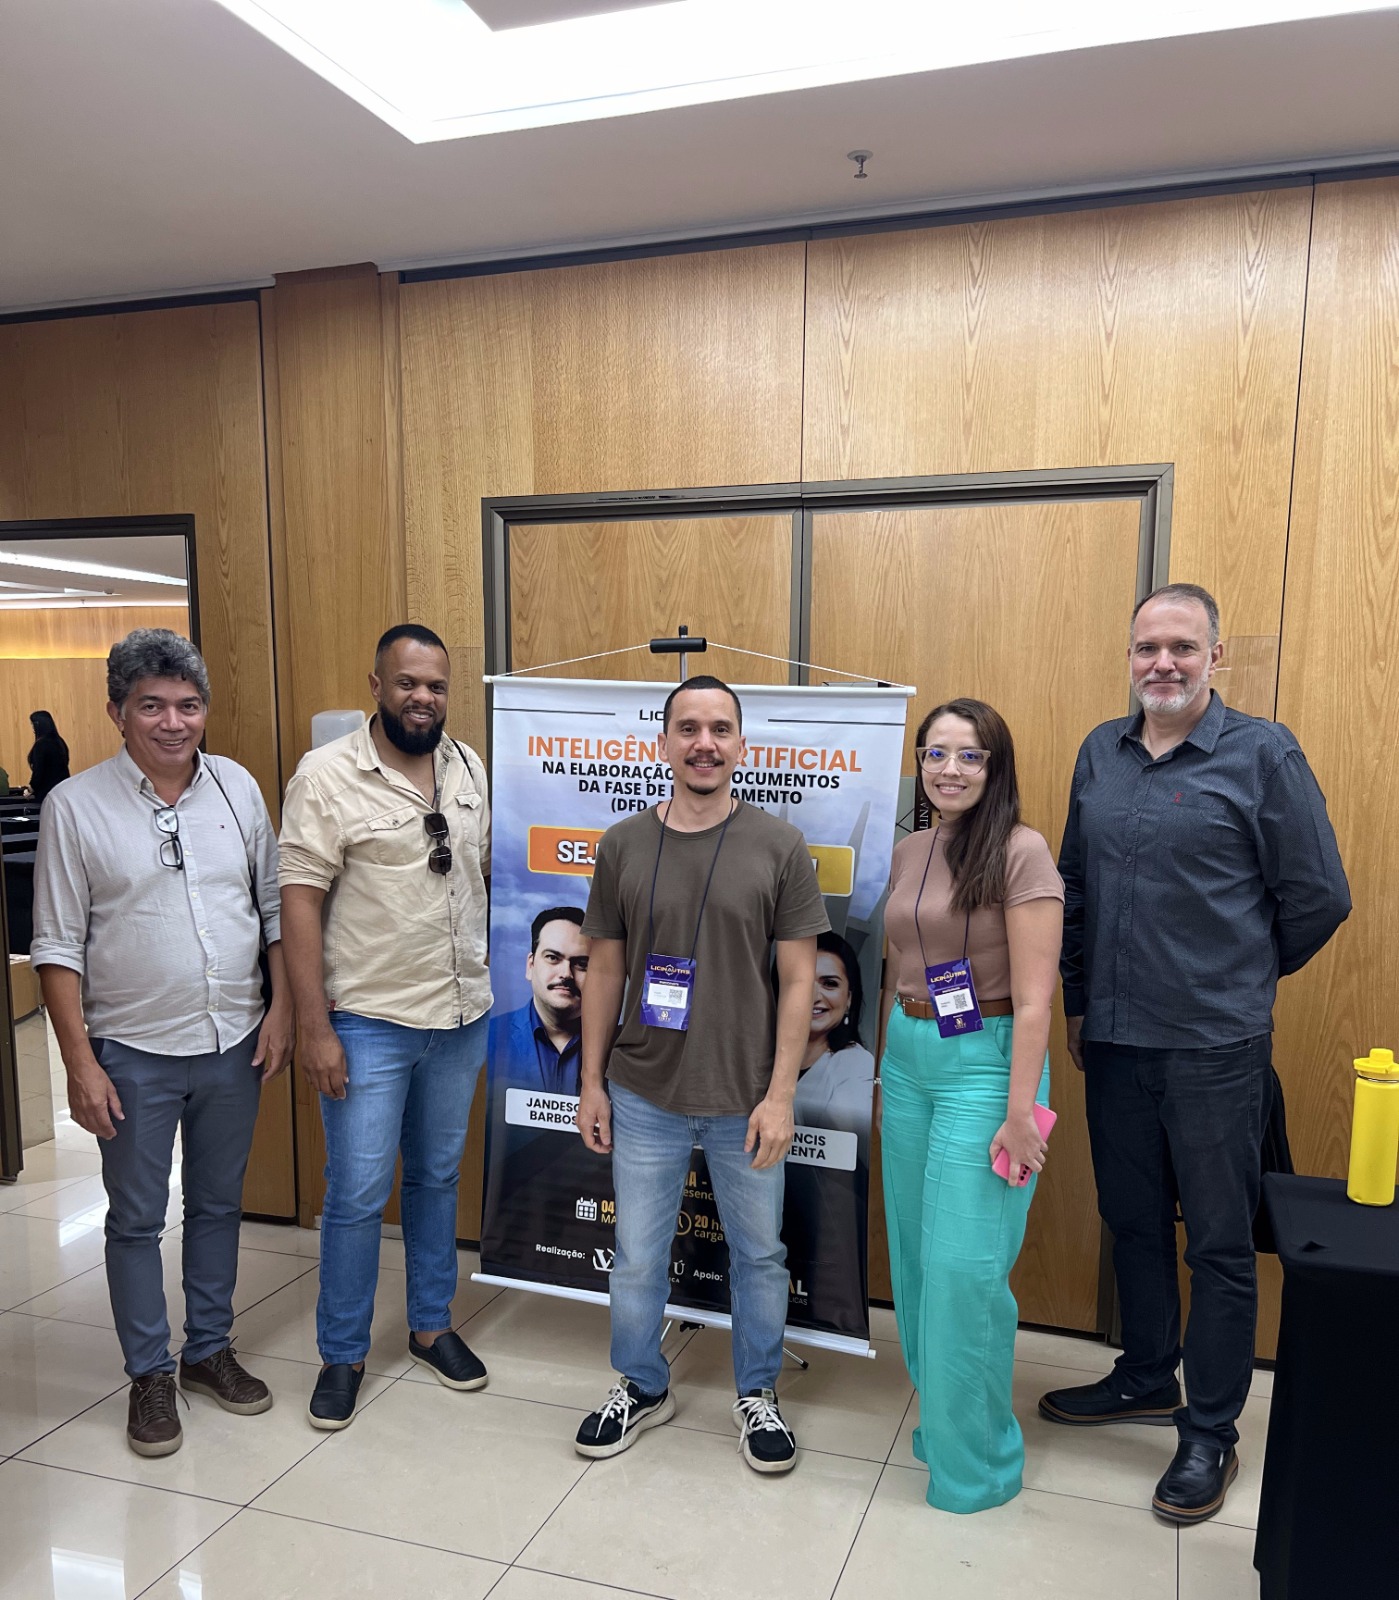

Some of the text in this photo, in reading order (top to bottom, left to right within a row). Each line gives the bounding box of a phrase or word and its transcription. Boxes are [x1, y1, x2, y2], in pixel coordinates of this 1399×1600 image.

[639, 709, 664, 721] LIC
[528, 735, 657, 762] INTELIGÊN
[542, 761, 840, 789] NA ELABORAÇÃO OCUMENTOS
[578, 780, 601, 793] DA
[605, 781, 641, 795] FASE
[646, 784, 666, 797] DE
[730, 788, 803, 804] AMENTO
[611, 798, 648, 813] (DFD
[919, 802, 929, 830] LINA
[557, 840, 599, 865] SEJ
[529, 1111, 577, 1126] BARBOS
[793, 1132, 826, 1146] NCIS
[788, 1145, 826, 1160] ENTA
[683, 1188, 714, 1200] esenc
[601, 1200, 615, 1214] 04
[601, 1214, 616, 1224] MA
[695, 1214, 709, 1229] 20
[694, 1229, 724, 1242] carga
[535, 1244, 586, 1259] Realização:
[693, 1269, 723, 1281] Apoio:
